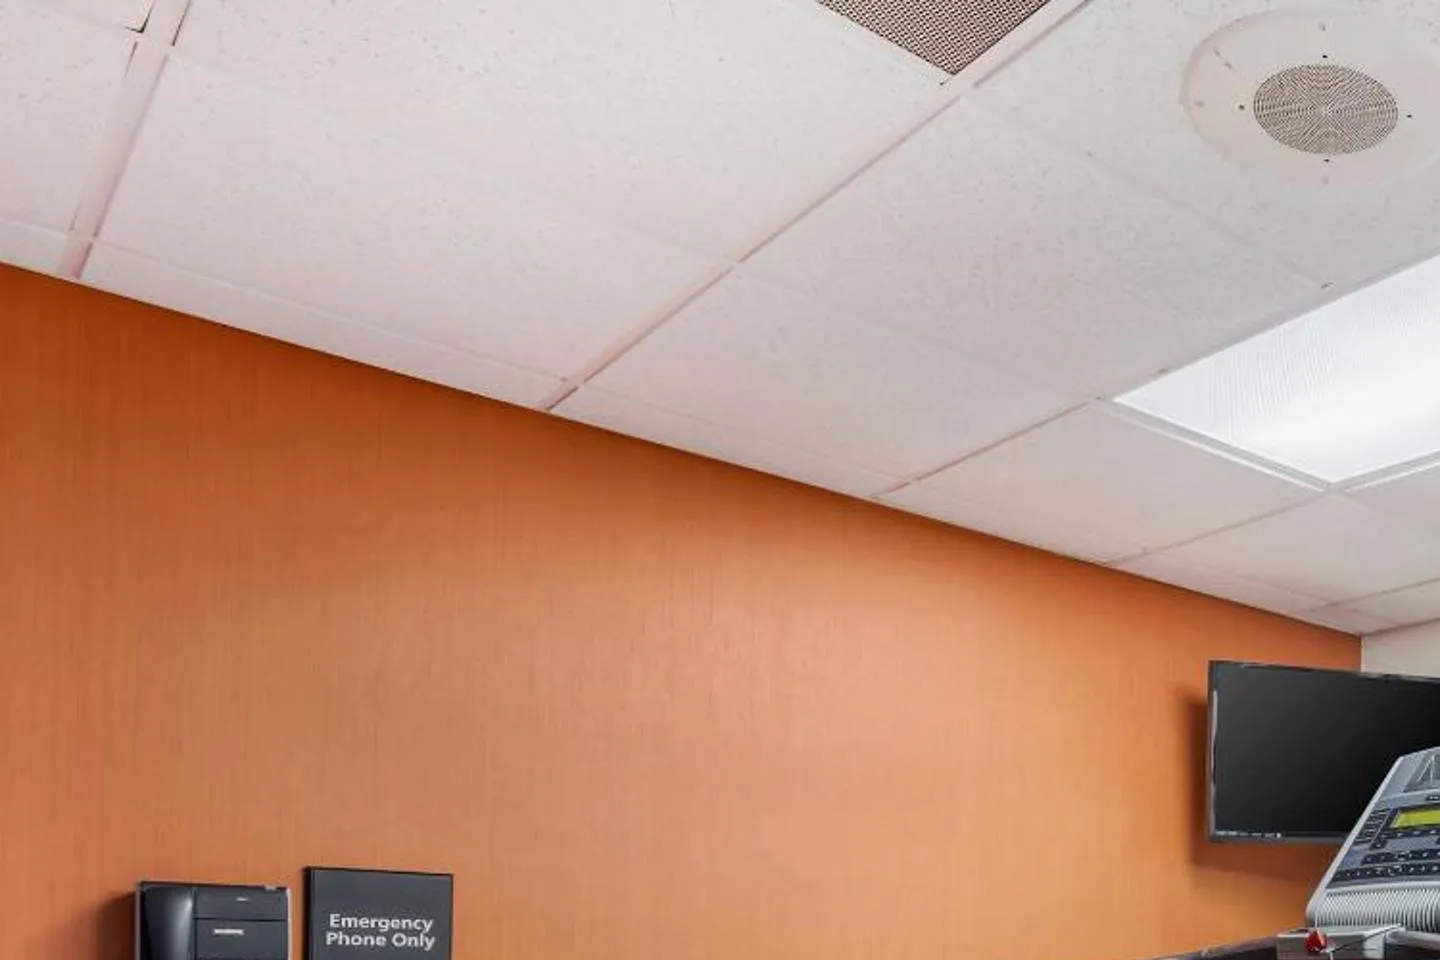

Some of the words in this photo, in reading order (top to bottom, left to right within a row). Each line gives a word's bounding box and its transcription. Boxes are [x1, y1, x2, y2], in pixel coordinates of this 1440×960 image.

[329, 913, 434, 933] Emergency
[325, 931, 387, 947] Phone
[391, 933, 436, 951] Only
